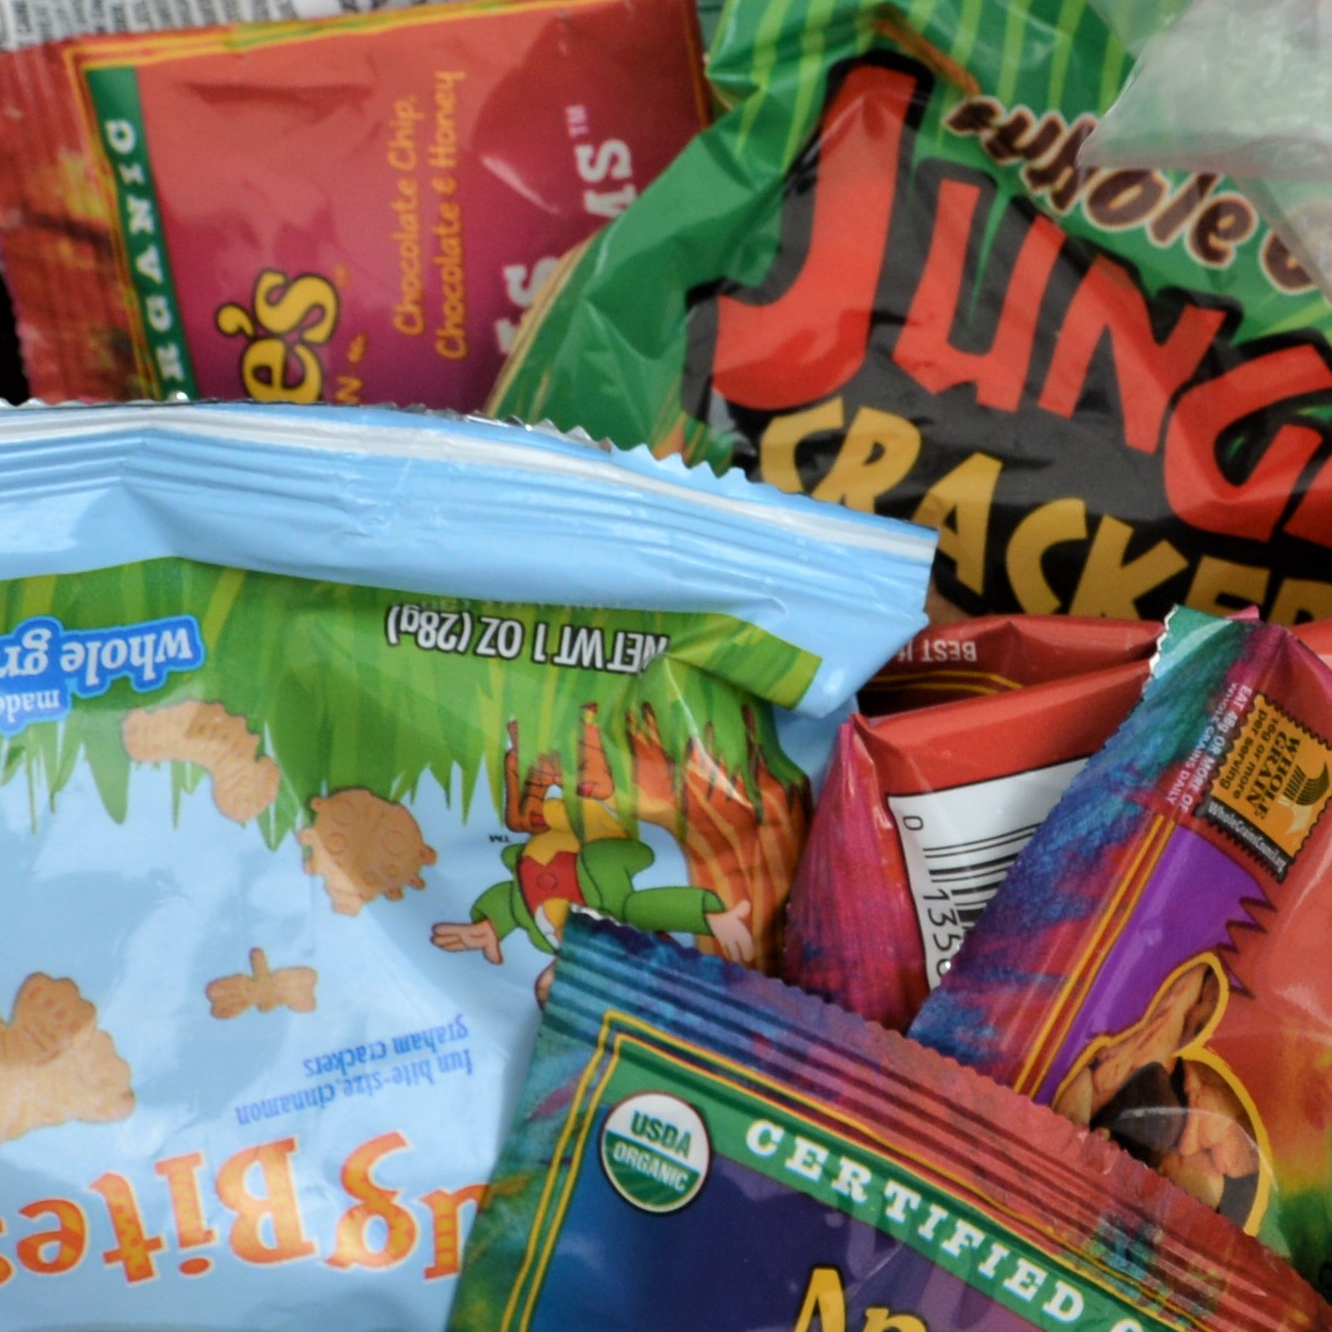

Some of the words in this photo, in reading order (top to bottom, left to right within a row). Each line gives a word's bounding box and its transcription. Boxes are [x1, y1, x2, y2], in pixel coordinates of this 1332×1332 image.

[428, 71, 464, 168] Honey
[393, 175, 424, 337] Chocolate
[435, 201, 468, 360] Chocolate
[388, 603, 475, 653] (28g)
[480, 617, 521, 659] OZ
[553, 629, 605, 668] WT
[922, 638, 978, 663] BEST
[60, 622, 194, 687] whole
[1, 691, 61, 724] made
[391, 1013, 469, 1054] graham
[302, 1041, 388, 1079] crackers
[437, 1049, 473, 1076] fun
[235, 1084, 336, 1126] cinnamon
[631, 1110, 694, 1160] USDA
[613, 1141, 690, 1195] ORGANIC
[744, 1117, 1086, 1323] CERTIFIED
